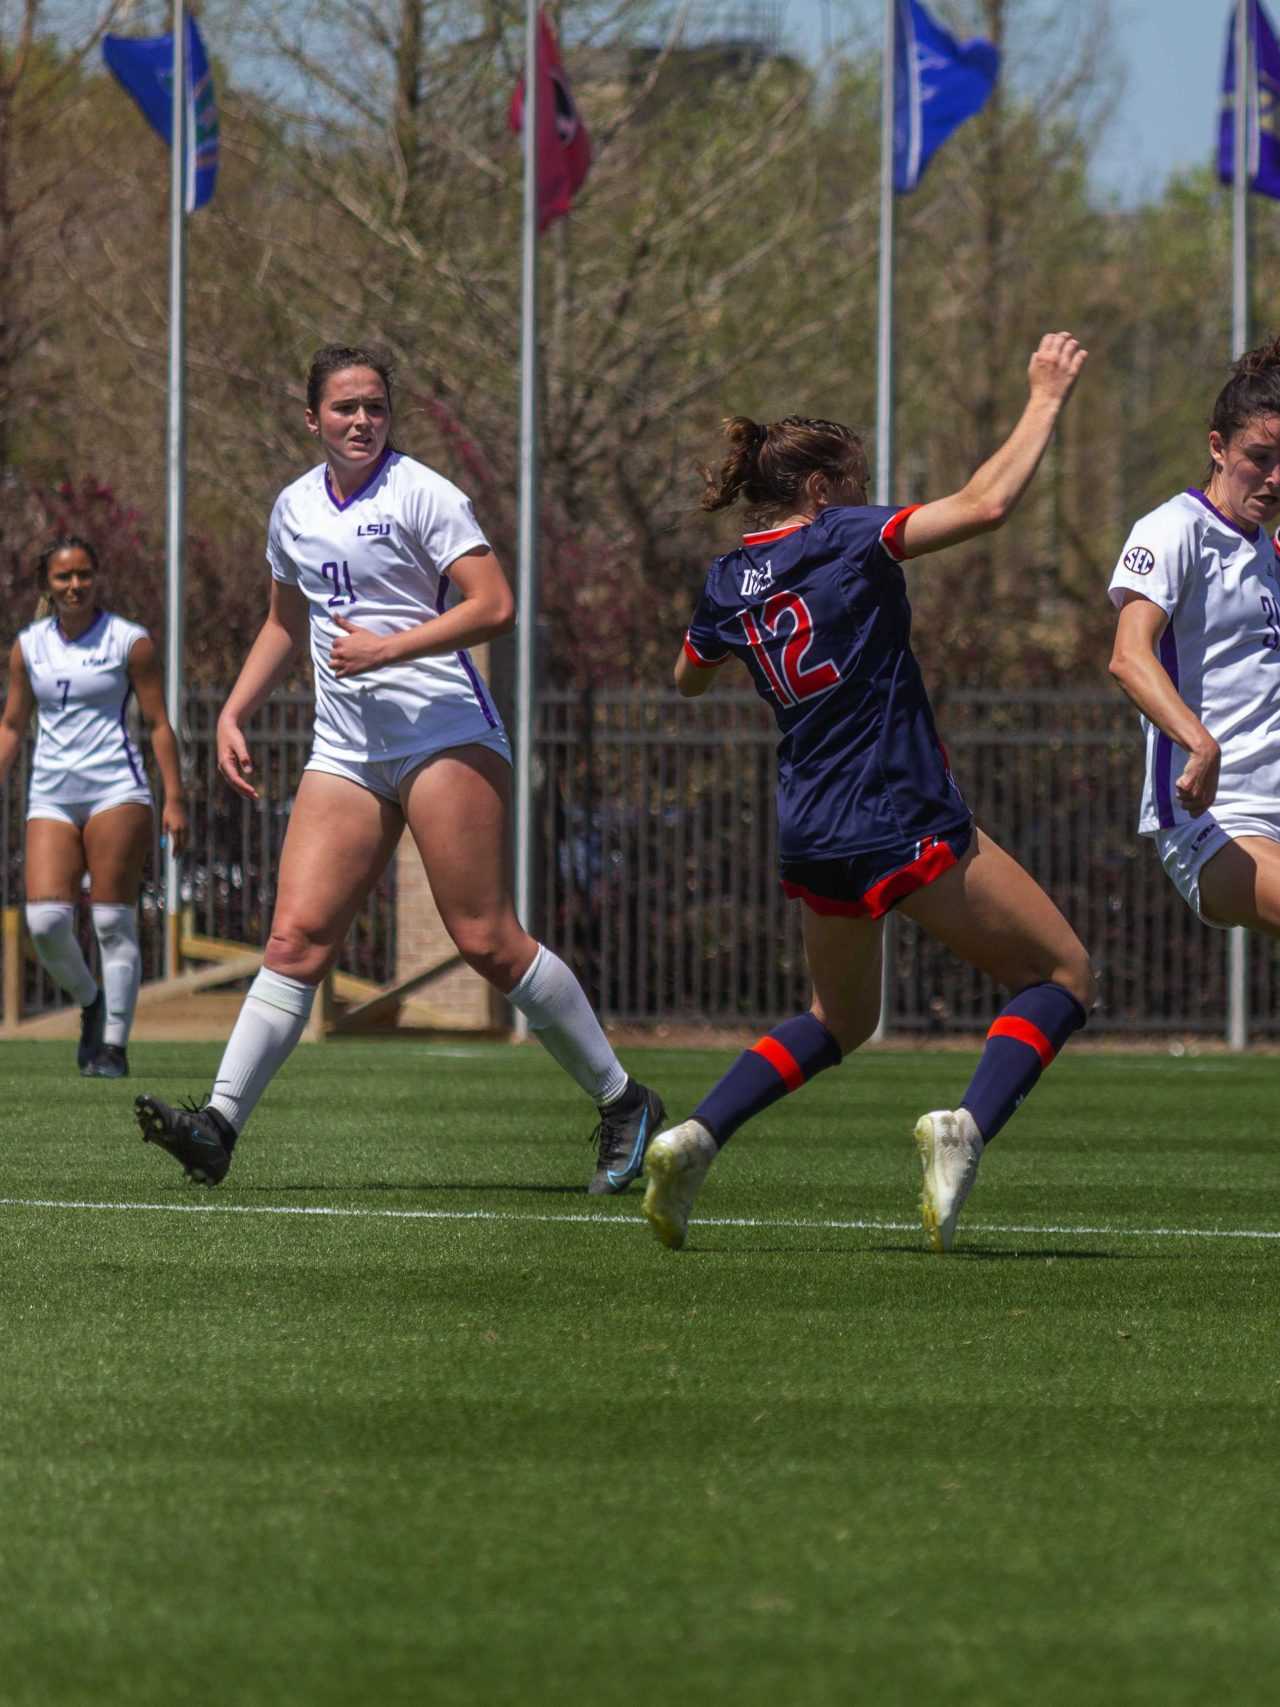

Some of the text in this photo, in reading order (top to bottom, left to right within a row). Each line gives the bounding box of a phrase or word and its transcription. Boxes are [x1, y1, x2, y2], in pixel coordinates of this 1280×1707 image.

[357, 523, 391, 537] LSU
[322, 560, 358, 608] 21
[735, 590, 844, 709] 12
[56, 679, 70, 711] 7
